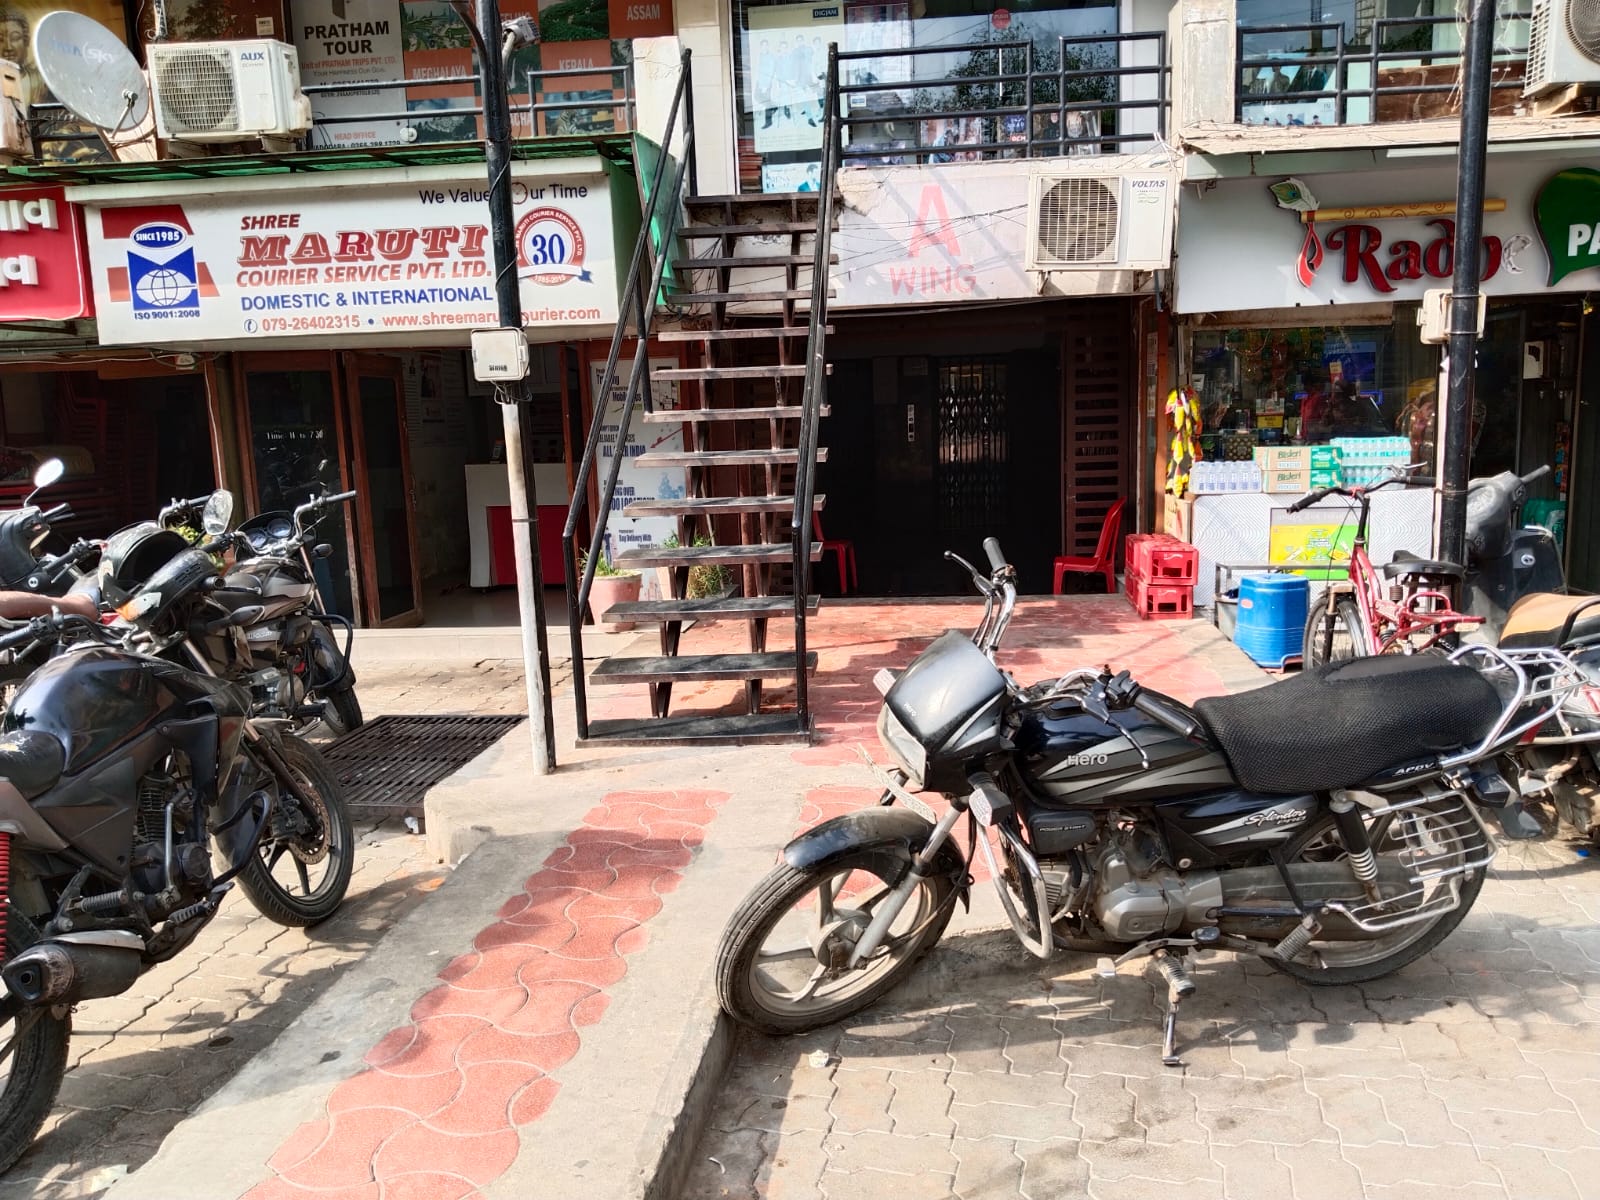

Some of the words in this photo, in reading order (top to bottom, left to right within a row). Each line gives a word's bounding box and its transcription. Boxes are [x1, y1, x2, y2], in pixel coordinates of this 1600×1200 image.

[627, 4, 661, 21] ASSAM
[304, 21, 390, 40] PRATHAM
[240, 52, 264, 60] AUX
[323, 40, 373, 56] TOUR
[413, 65, 467, 79] MEGHALAYA
[334, 132, 352, 141] HEAD
[353, 131, 376, 140] OFFICE
[1132, 180, 1166, 188] VOLTAS
[419, 189, 445, 204] We
[549, 183, 588, 199] Time
[241, 214, 301, 230] SHREE
[907, 184, 961, 258] A
[136, 232, 155, 241] SINCE
[156, 231, 181, 242] 1985
[237, 224, 489, 267] MARUTI
[531, 233, 565, 265] 30
[236, 267, 319, 287] COURIER
[324, 264, 402, 284] SERVICE
[407, 262, 446, 280] PVT.
[452, 260, 492, 278] LTD.
[889, 263, 977, 296] WING
[241, 293, 330, 311] DOMESTIC
[336, 293, 348, 307] &
[352, 286, 494, 306] INTERNATIONAL
[134, 312, 150, 320] ISO
[152, 310, 200, 319] 9001:2008
[262, 315, 360, 332] 079-26402315
[1245, 809, 1307, 827] Splendor
